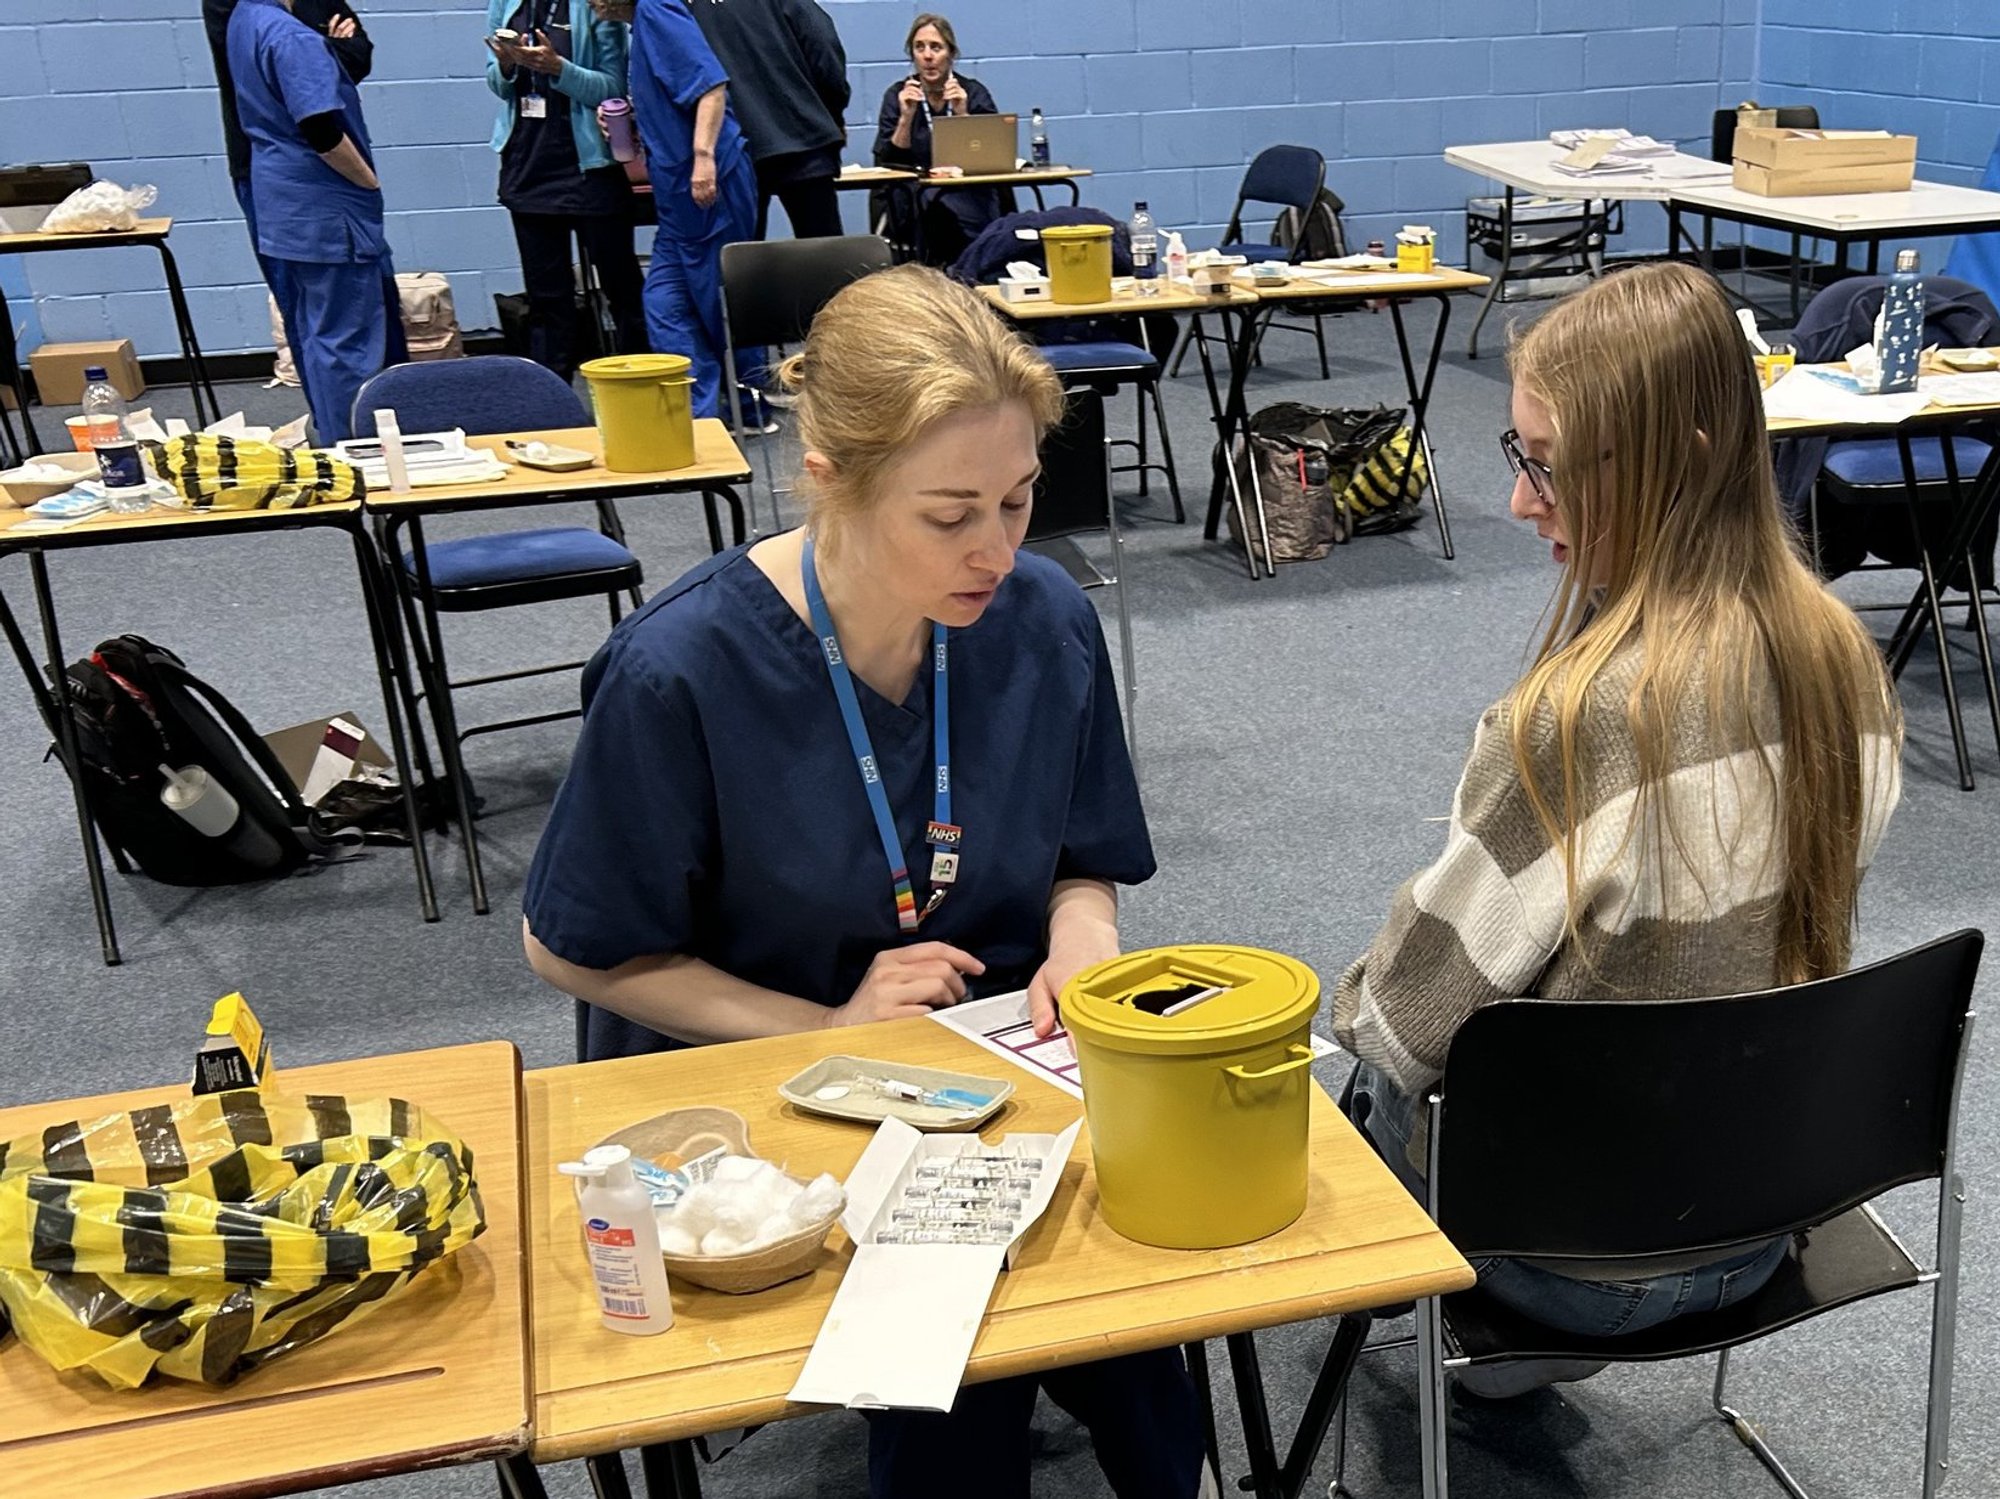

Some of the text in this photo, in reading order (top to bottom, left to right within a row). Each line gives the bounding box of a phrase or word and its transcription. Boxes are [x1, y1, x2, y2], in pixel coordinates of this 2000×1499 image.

[825, 638, 841, 664] NHS
[937, 645, 945, 670] NHS
[861, 757, 877, 782] NHS
[938, 767, 946, 791] NHS
[931, 828, 956, 843] NHS
